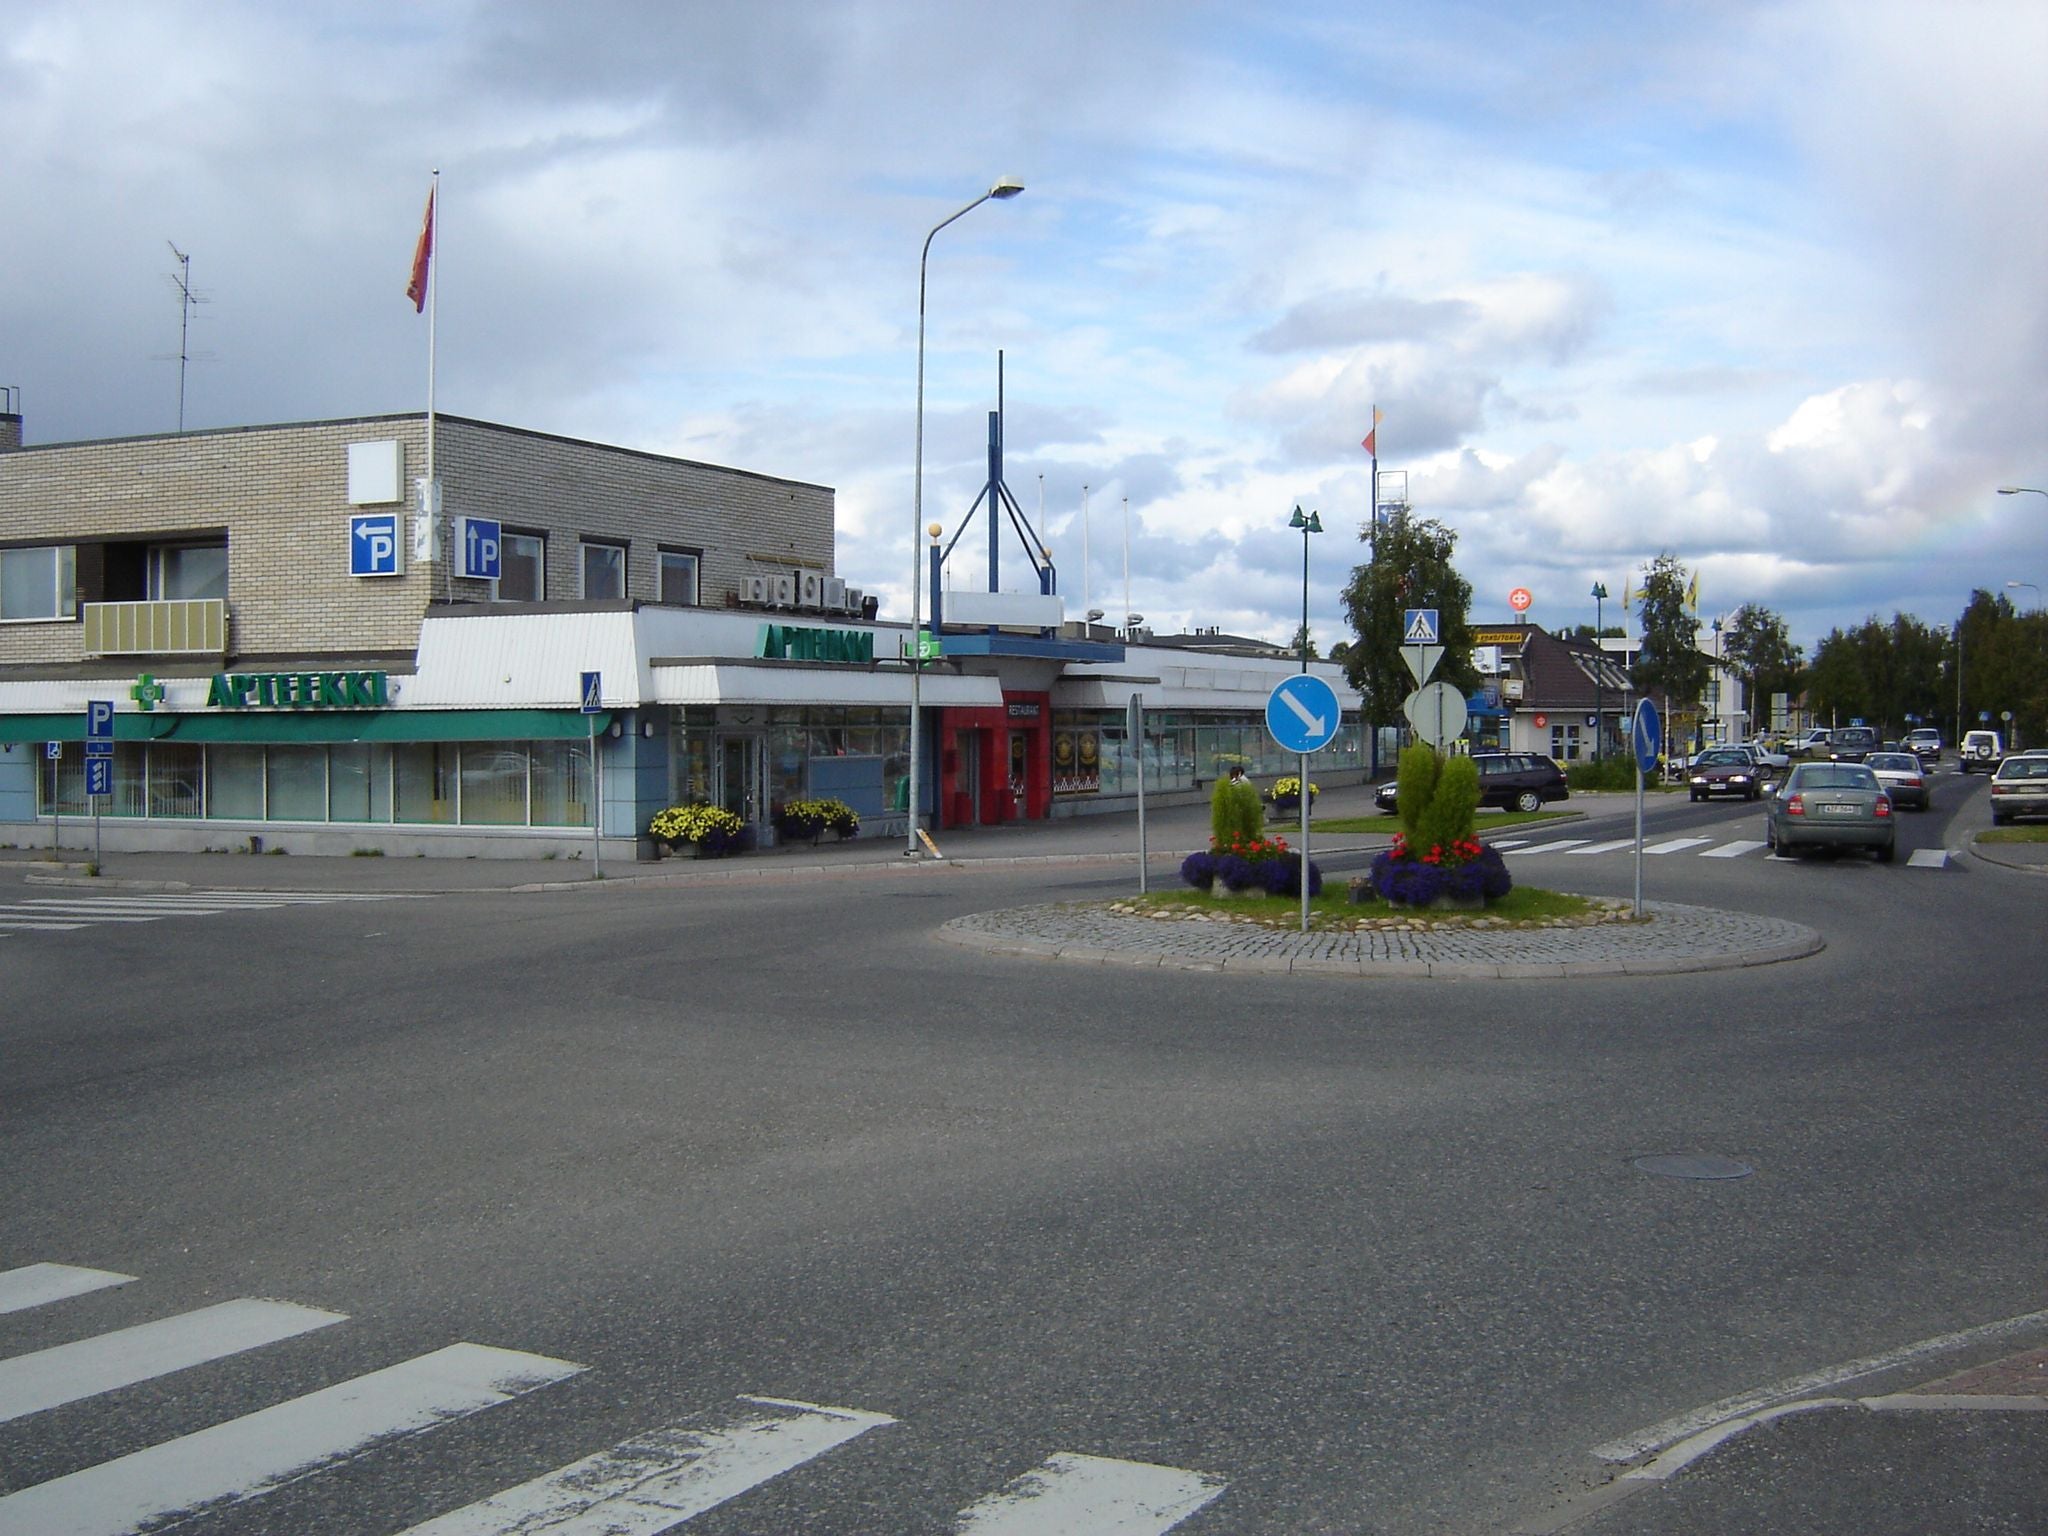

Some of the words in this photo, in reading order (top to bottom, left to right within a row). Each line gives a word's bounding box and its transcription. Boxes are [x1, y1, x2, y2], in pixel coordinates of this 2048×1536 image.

[371, 536, 393, 571] P
[481, 538, 498, 572] P
[760, 624, 874, 663] APTEEKKI
[206, 671, 388, 707] APTEEKKI
[93, 703, 110, 734] P
